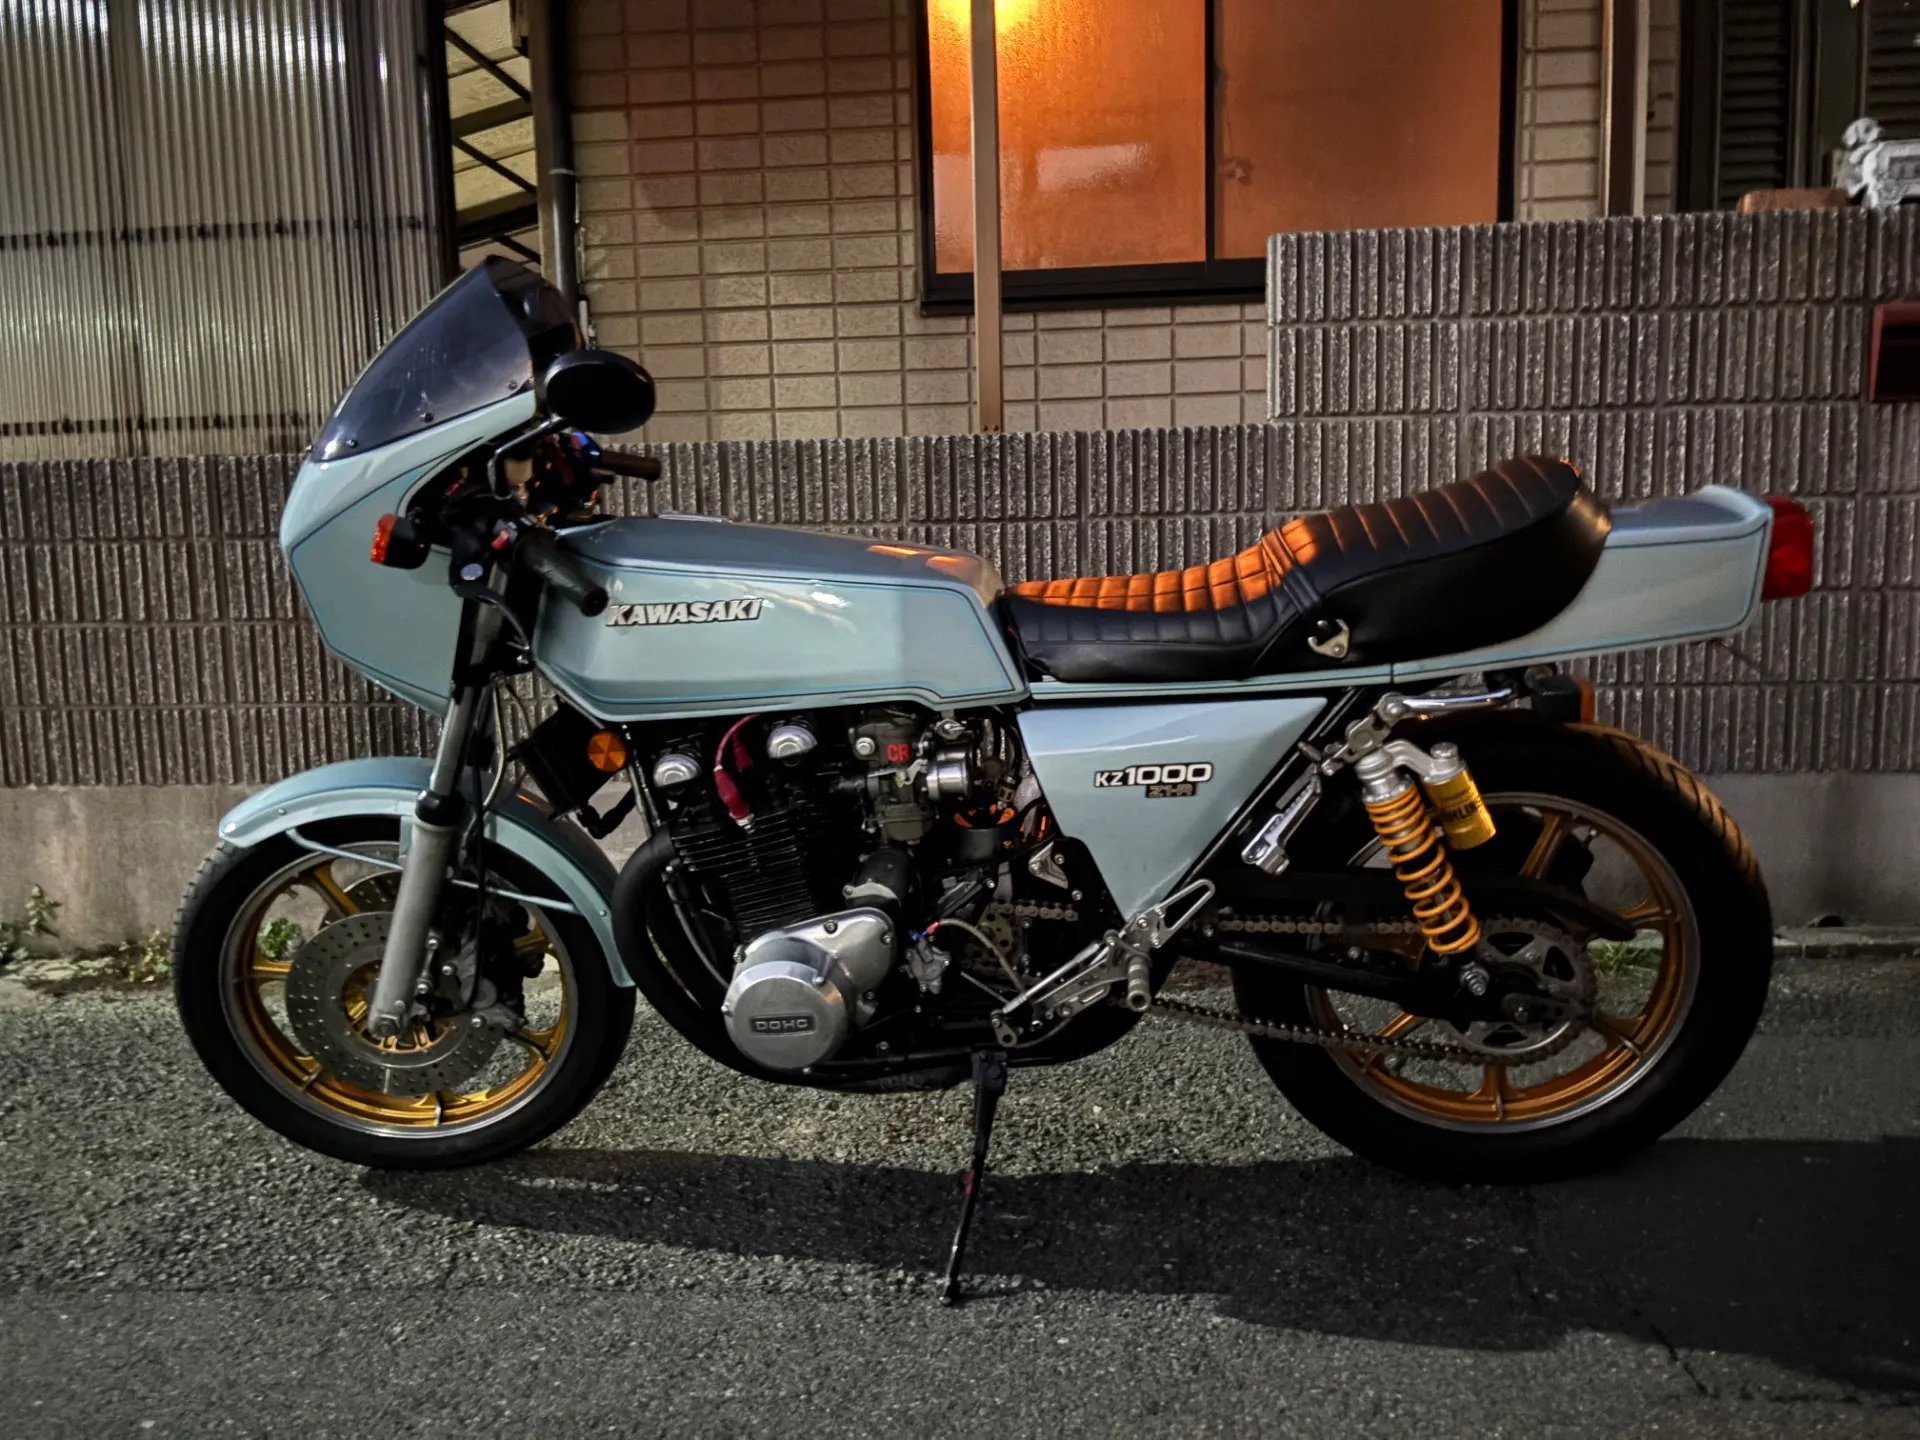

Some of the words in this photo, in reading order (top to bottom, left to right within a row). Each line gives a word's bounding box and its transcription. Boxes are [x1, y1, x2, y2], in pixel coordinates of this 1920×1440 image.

[606, 598, 763, 626] KAWASAKI
[886, 743, 910, 762] CR
[1095, 762, 1213, 788] KZ1000
[755, 1018, 809, 1031] DOHC
